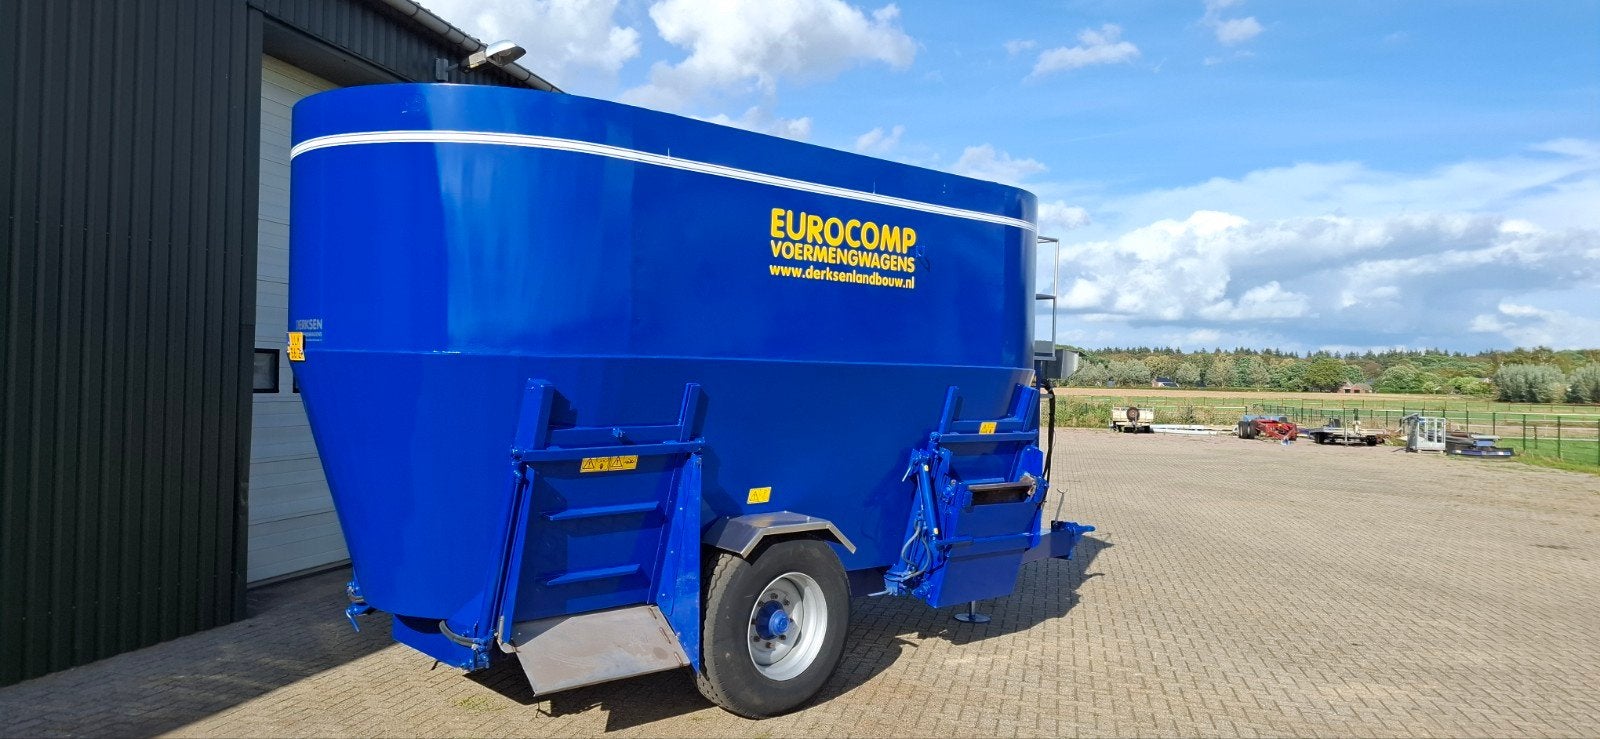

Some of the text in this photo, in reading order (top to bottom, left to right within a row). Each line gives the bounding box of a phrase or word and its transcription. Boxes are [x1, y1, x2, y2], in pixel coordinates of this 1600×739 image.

[770, 208, 917, 254] EUROCOMP
[770, 240, 916, 273] VOERMENGWAGENS
[769, 264, 915, 289] www.derksenlandbouw.nl
